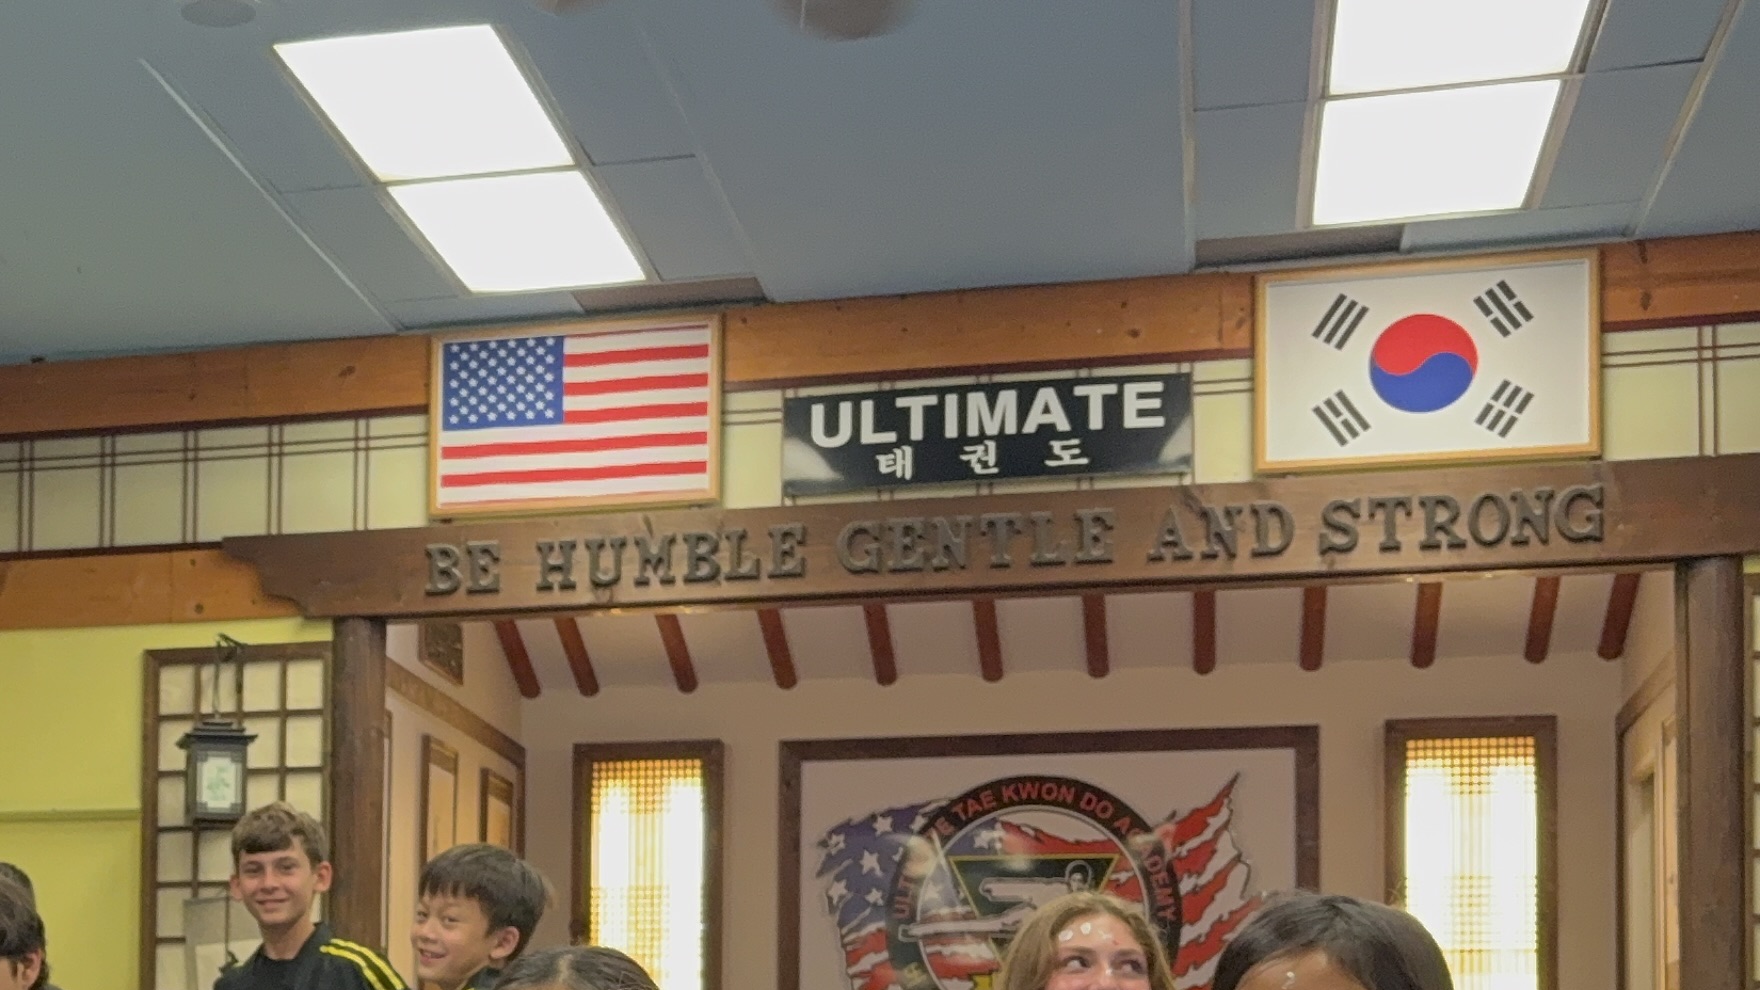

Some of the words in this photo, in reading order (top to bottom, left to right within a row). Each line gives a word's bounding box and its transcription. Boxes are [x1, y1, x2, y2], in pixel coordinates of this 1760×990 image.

[810, 381, 1166, 448] ULTIMATE
[425, 541, 501, 596] BE
[536, 524, 808, 591] HUMBLE
[838, 508, 1115, 574] GENTLE
[1147, 500, 1295, 563] AND
[1318, 483, 1606, 556] STRONG
[951, 790, 998, 821] TAE
[1001, 781, 1076, 805] KWON
[1080, 792, 1114, 819] DO
